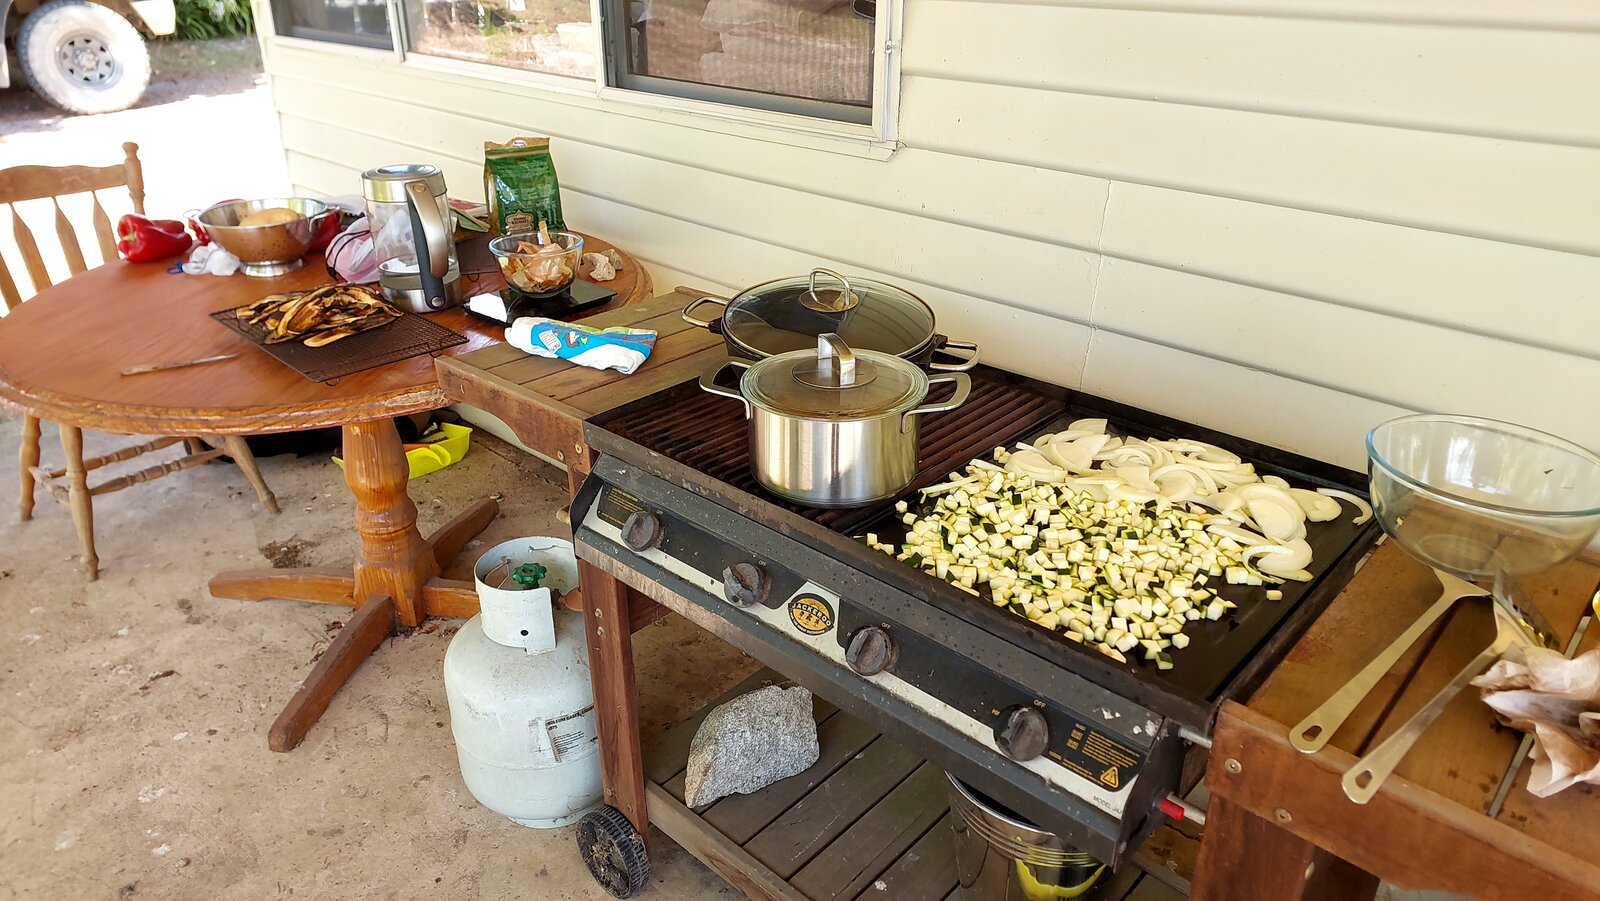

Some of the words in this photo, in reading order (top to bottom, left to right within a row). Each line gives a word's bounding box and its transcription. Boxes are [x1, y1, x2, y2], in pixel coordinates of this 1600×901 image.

[791, 602, 831, 626] JACKEROO
[881, 621, 892, 630] OFF
[1033, 699, 1047, 709] OFF
[1093, 795, 1112, 810] MODEL
